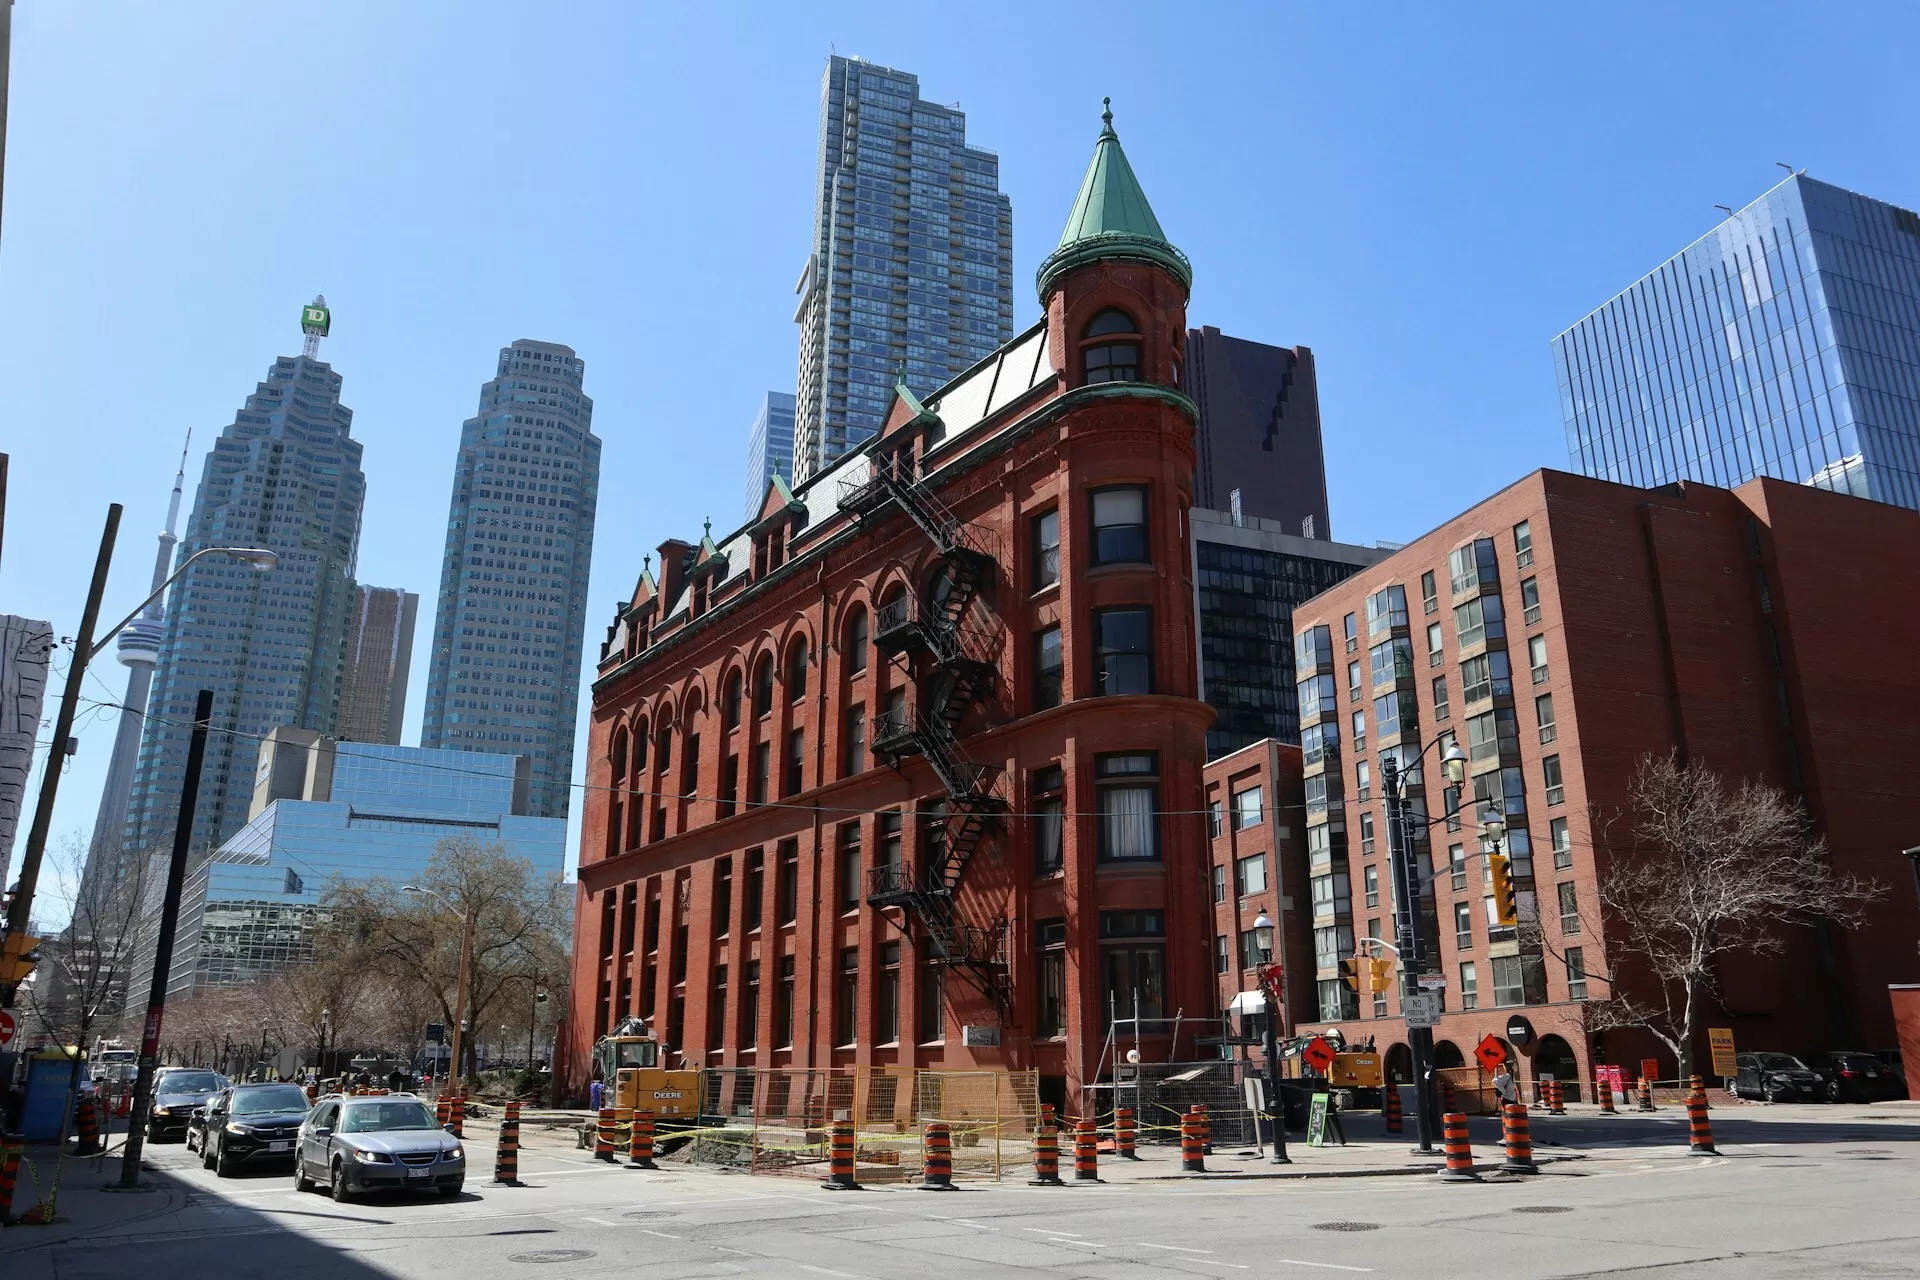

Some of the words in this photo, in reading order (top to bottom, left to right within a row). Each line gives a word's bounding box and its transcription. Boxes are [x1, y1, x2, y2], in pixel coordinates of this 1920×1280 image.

[306, 308, 325, 322] TD
[1412, 999, 1422, 1008] NO
[653, 1091, 682, 1099] DEERE
